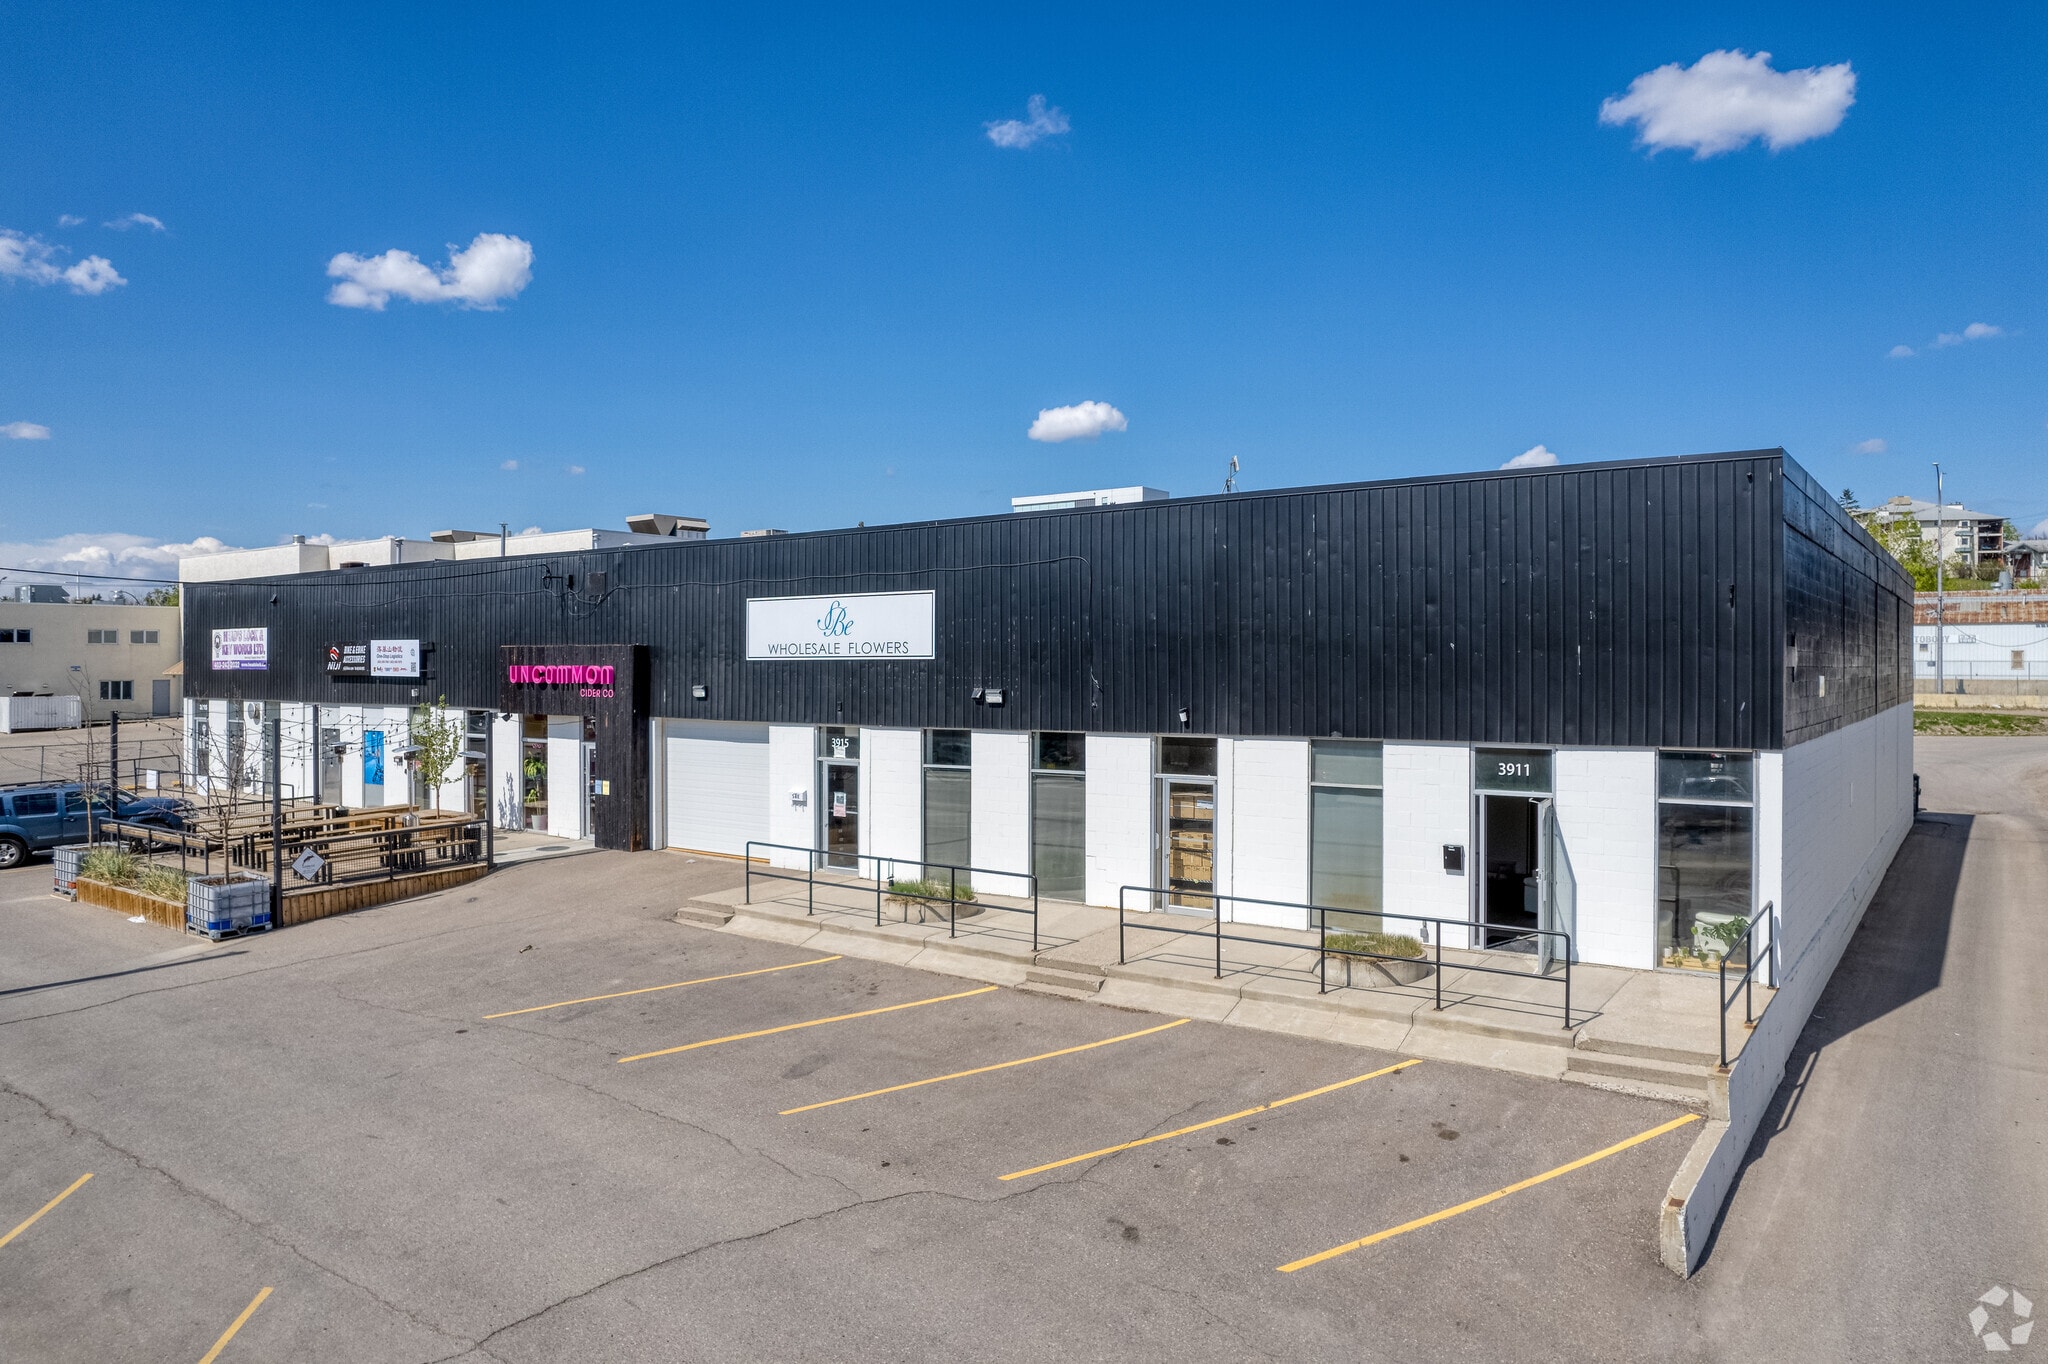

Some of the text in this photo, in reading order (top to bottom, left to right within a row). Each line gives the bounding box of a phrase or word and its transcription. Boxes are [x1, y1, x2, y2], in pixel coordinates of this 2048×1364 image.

[767, 641, 909, 655] WHOLESALE FLOWERS
[509, 664, 615, 685] UNCOMMON
[580, 688, 614, 698] CIDER CO
[831, 737, 849, 748] 3915
[1497, 762, 1530, 777] 3911
